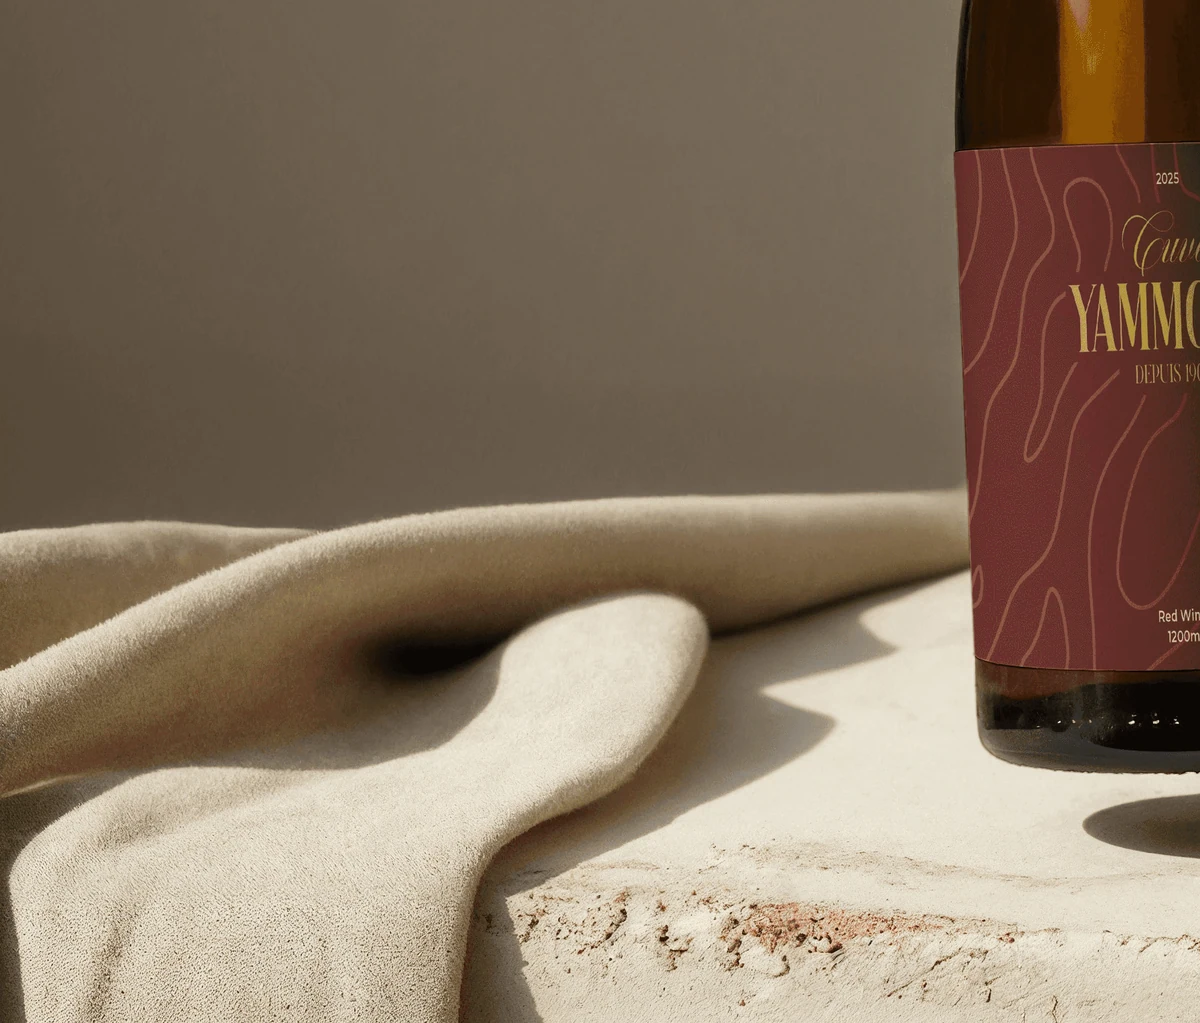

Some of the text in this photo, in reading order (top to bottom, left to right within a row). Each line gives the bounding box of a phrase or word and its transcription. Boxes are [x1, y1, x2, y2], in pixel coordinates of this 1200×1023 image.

[1155, 171, 1180, 185] 2025
[1135, 362, 1182, 384] DEPUIS
[1158, 608, 1178, 623] Red
[1167, 629, 1200, 643] 1200m
